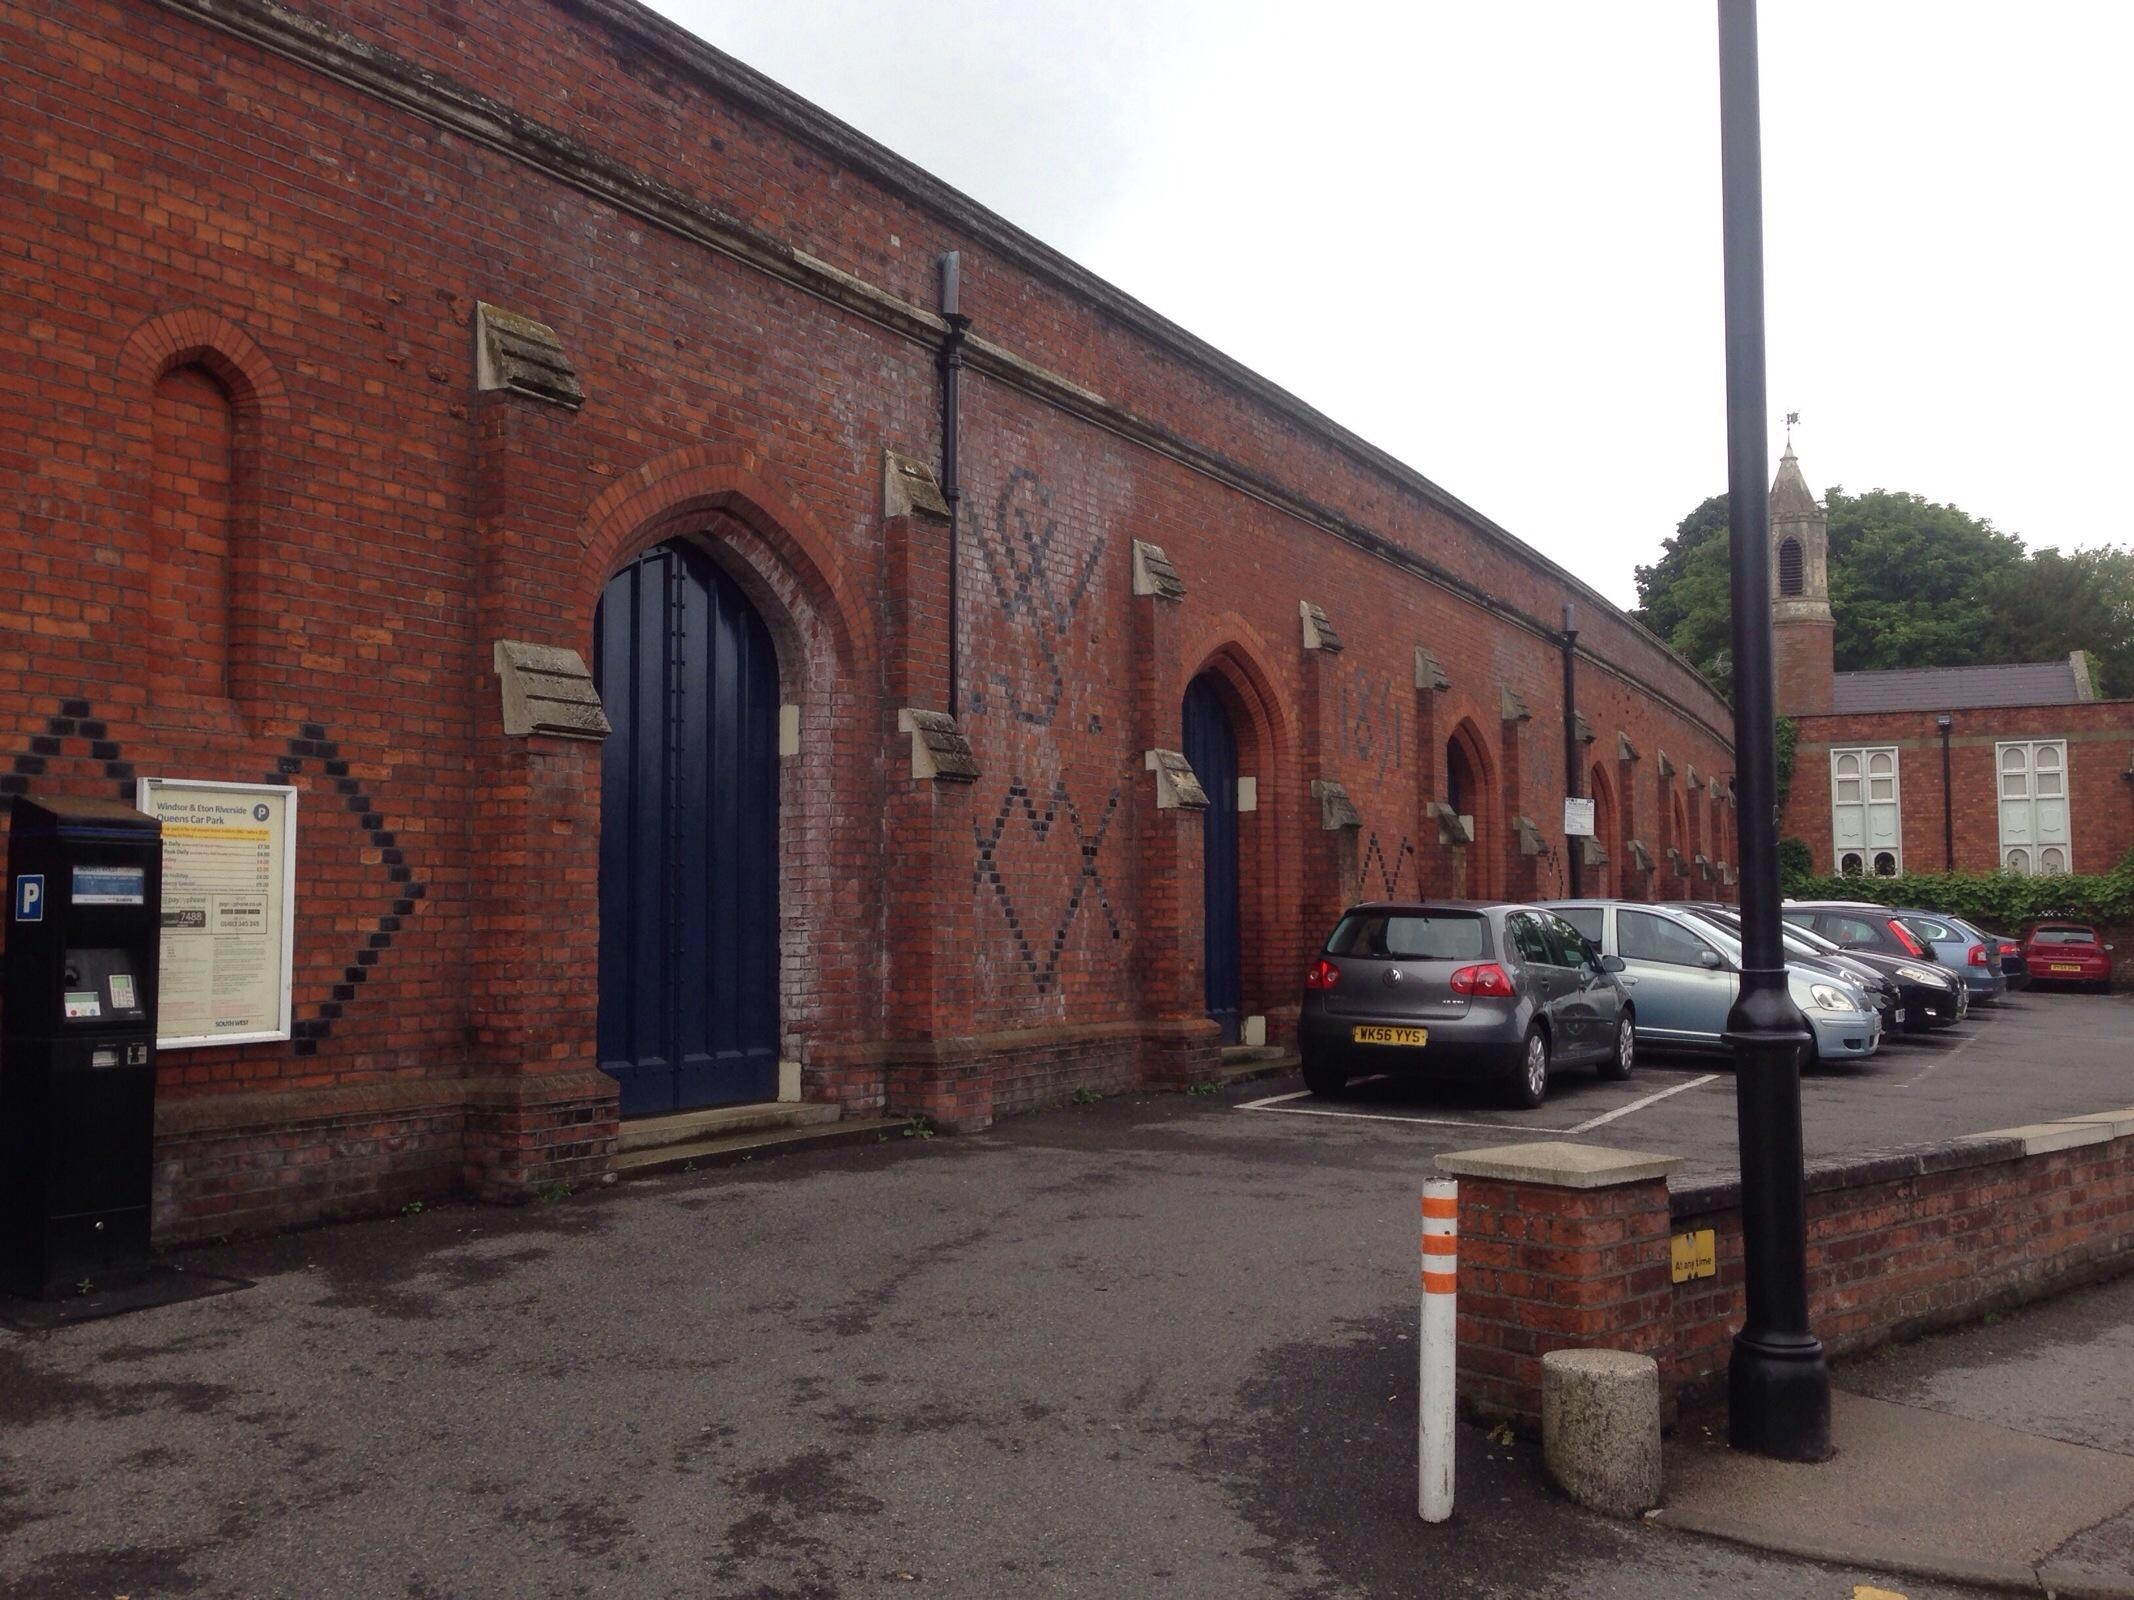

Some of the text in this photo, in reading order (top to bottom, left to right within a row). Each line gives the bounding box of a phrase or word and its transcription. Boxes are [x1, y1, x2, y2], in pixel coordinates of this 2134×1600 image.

[157, 802, 188, 811] Windsor
[190, 803, 197, 812] &
[198, 803, 214, 813] Eton
[215, 805, 248, 815] Riverside
[156, 813, 225, 825] Queens Car Park
[23, 883, 39, 913] P
[181, 911, 202, 921] 7488
[1360, 1027, 1421, 1043] WK56 YYS
[1675, 1256, 1712, 1272] At any time
